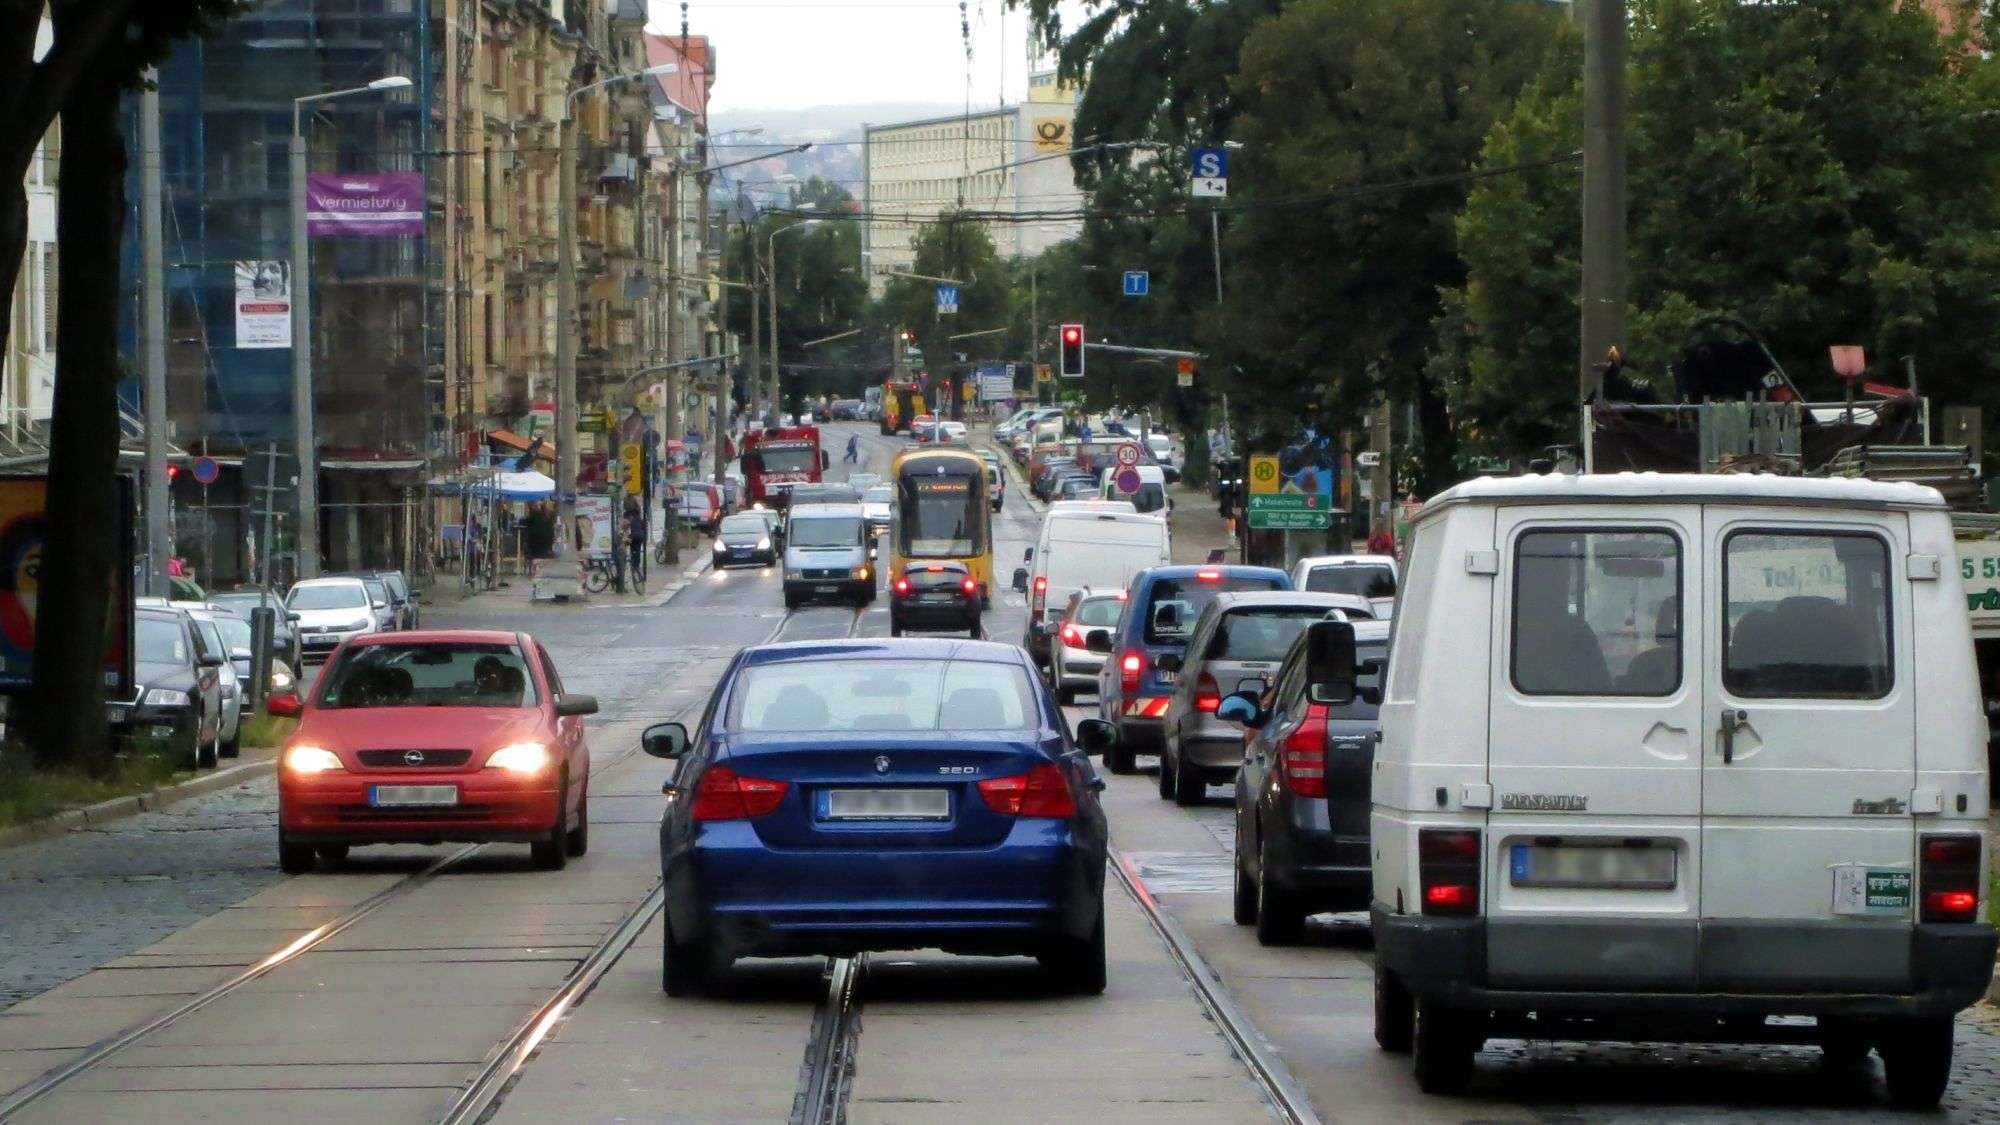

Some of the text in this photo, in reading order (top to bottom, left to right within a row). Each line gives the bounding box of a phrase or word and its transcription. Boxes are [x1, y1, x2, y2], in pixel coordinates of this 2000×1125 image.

[1200, 153, 1220, 177] S
[316, 194, 407, 211] Vermietung
[938, 288, 957, 305] W
[1122, 449, 1136, 461] 30
[1962, 558, 1975, 579] 5
[939, 766, 980, 775] 320i
